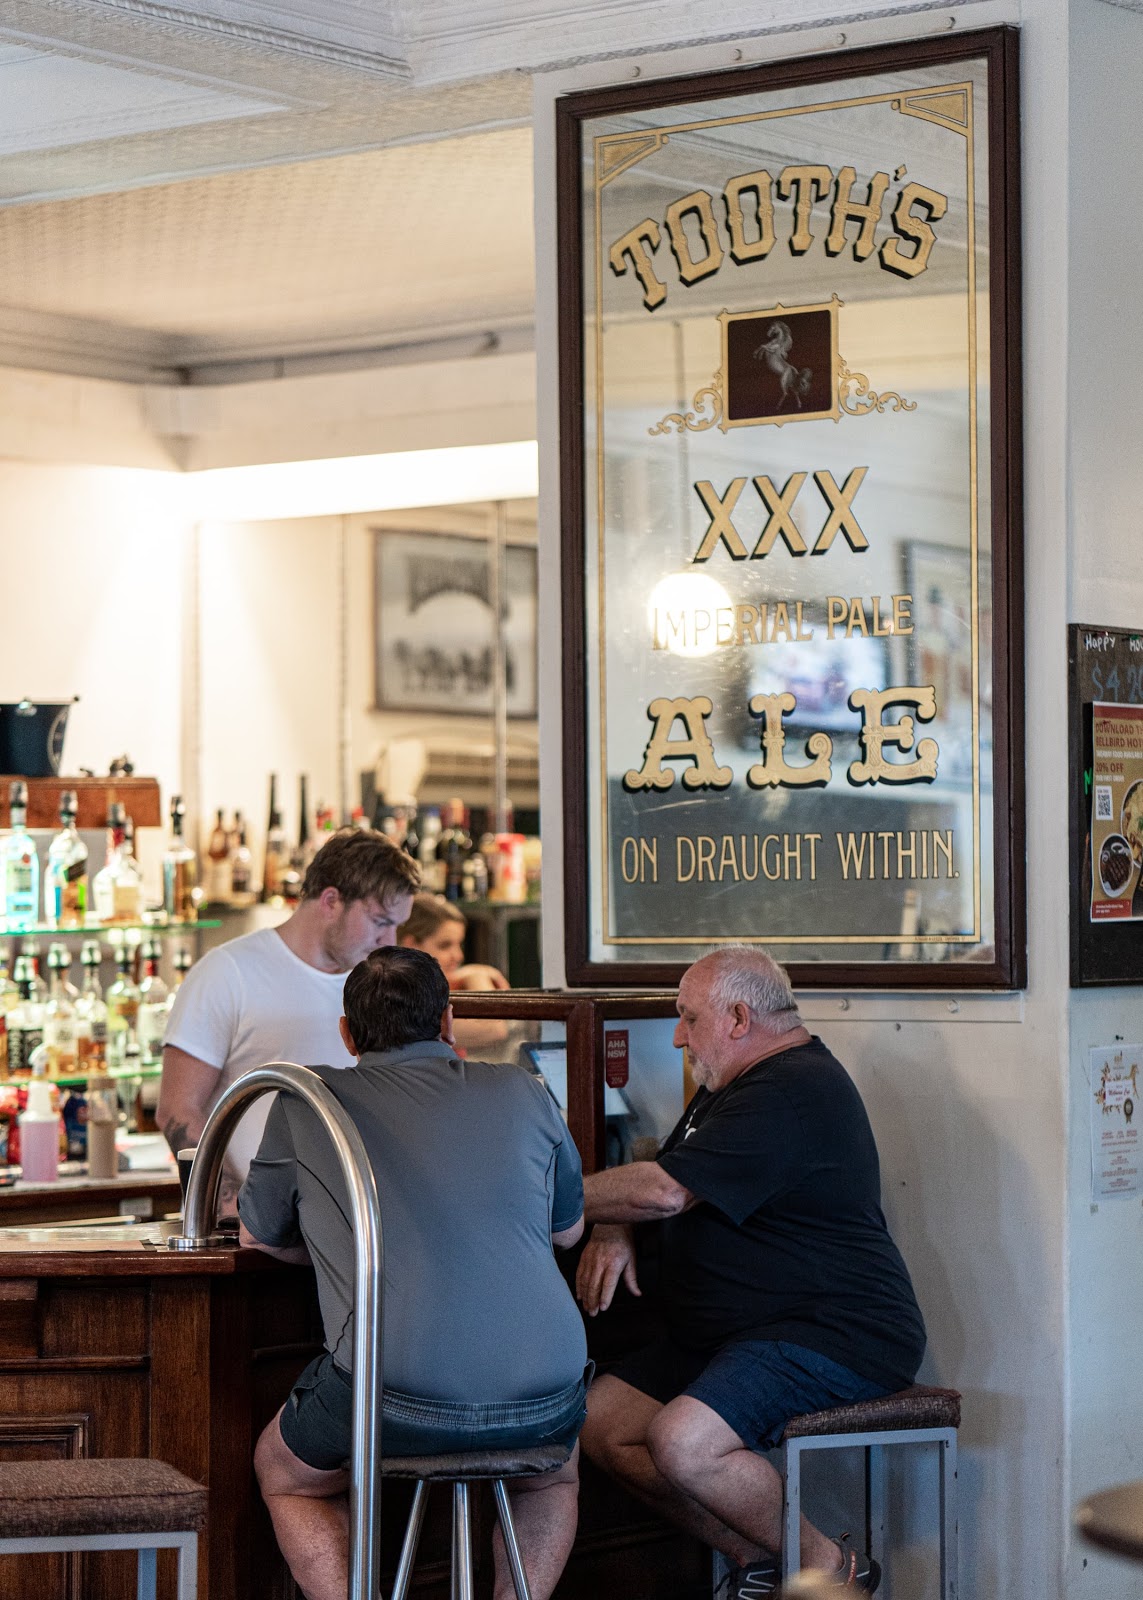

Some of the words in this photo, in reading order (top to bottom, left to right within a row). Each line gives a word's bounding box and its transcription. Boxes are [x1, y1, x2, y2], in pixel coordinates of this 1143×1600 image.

[609, 164, 948, 312] TOOTH'S
[693, 466, 869, 563] XXX
[652, 601, 814, 650] IMPERIAL
[826, 594, 914, 640] PALE
[1085, 633, 1116, 652] Happy
[622, 685, 939, 793] ALE
[1096, 723, 1134, 735] DOWNLOAD
[1110, 762, 1124, 773] OFF
[621, 836, 658, 883] ON
[676, 833, 823, 882] DRAUGHT
[836, 830, 960, 880] WITHIN.
[607, 1040, 626, 1048] AHA
[607, 1050, 626, 1058] NSW
